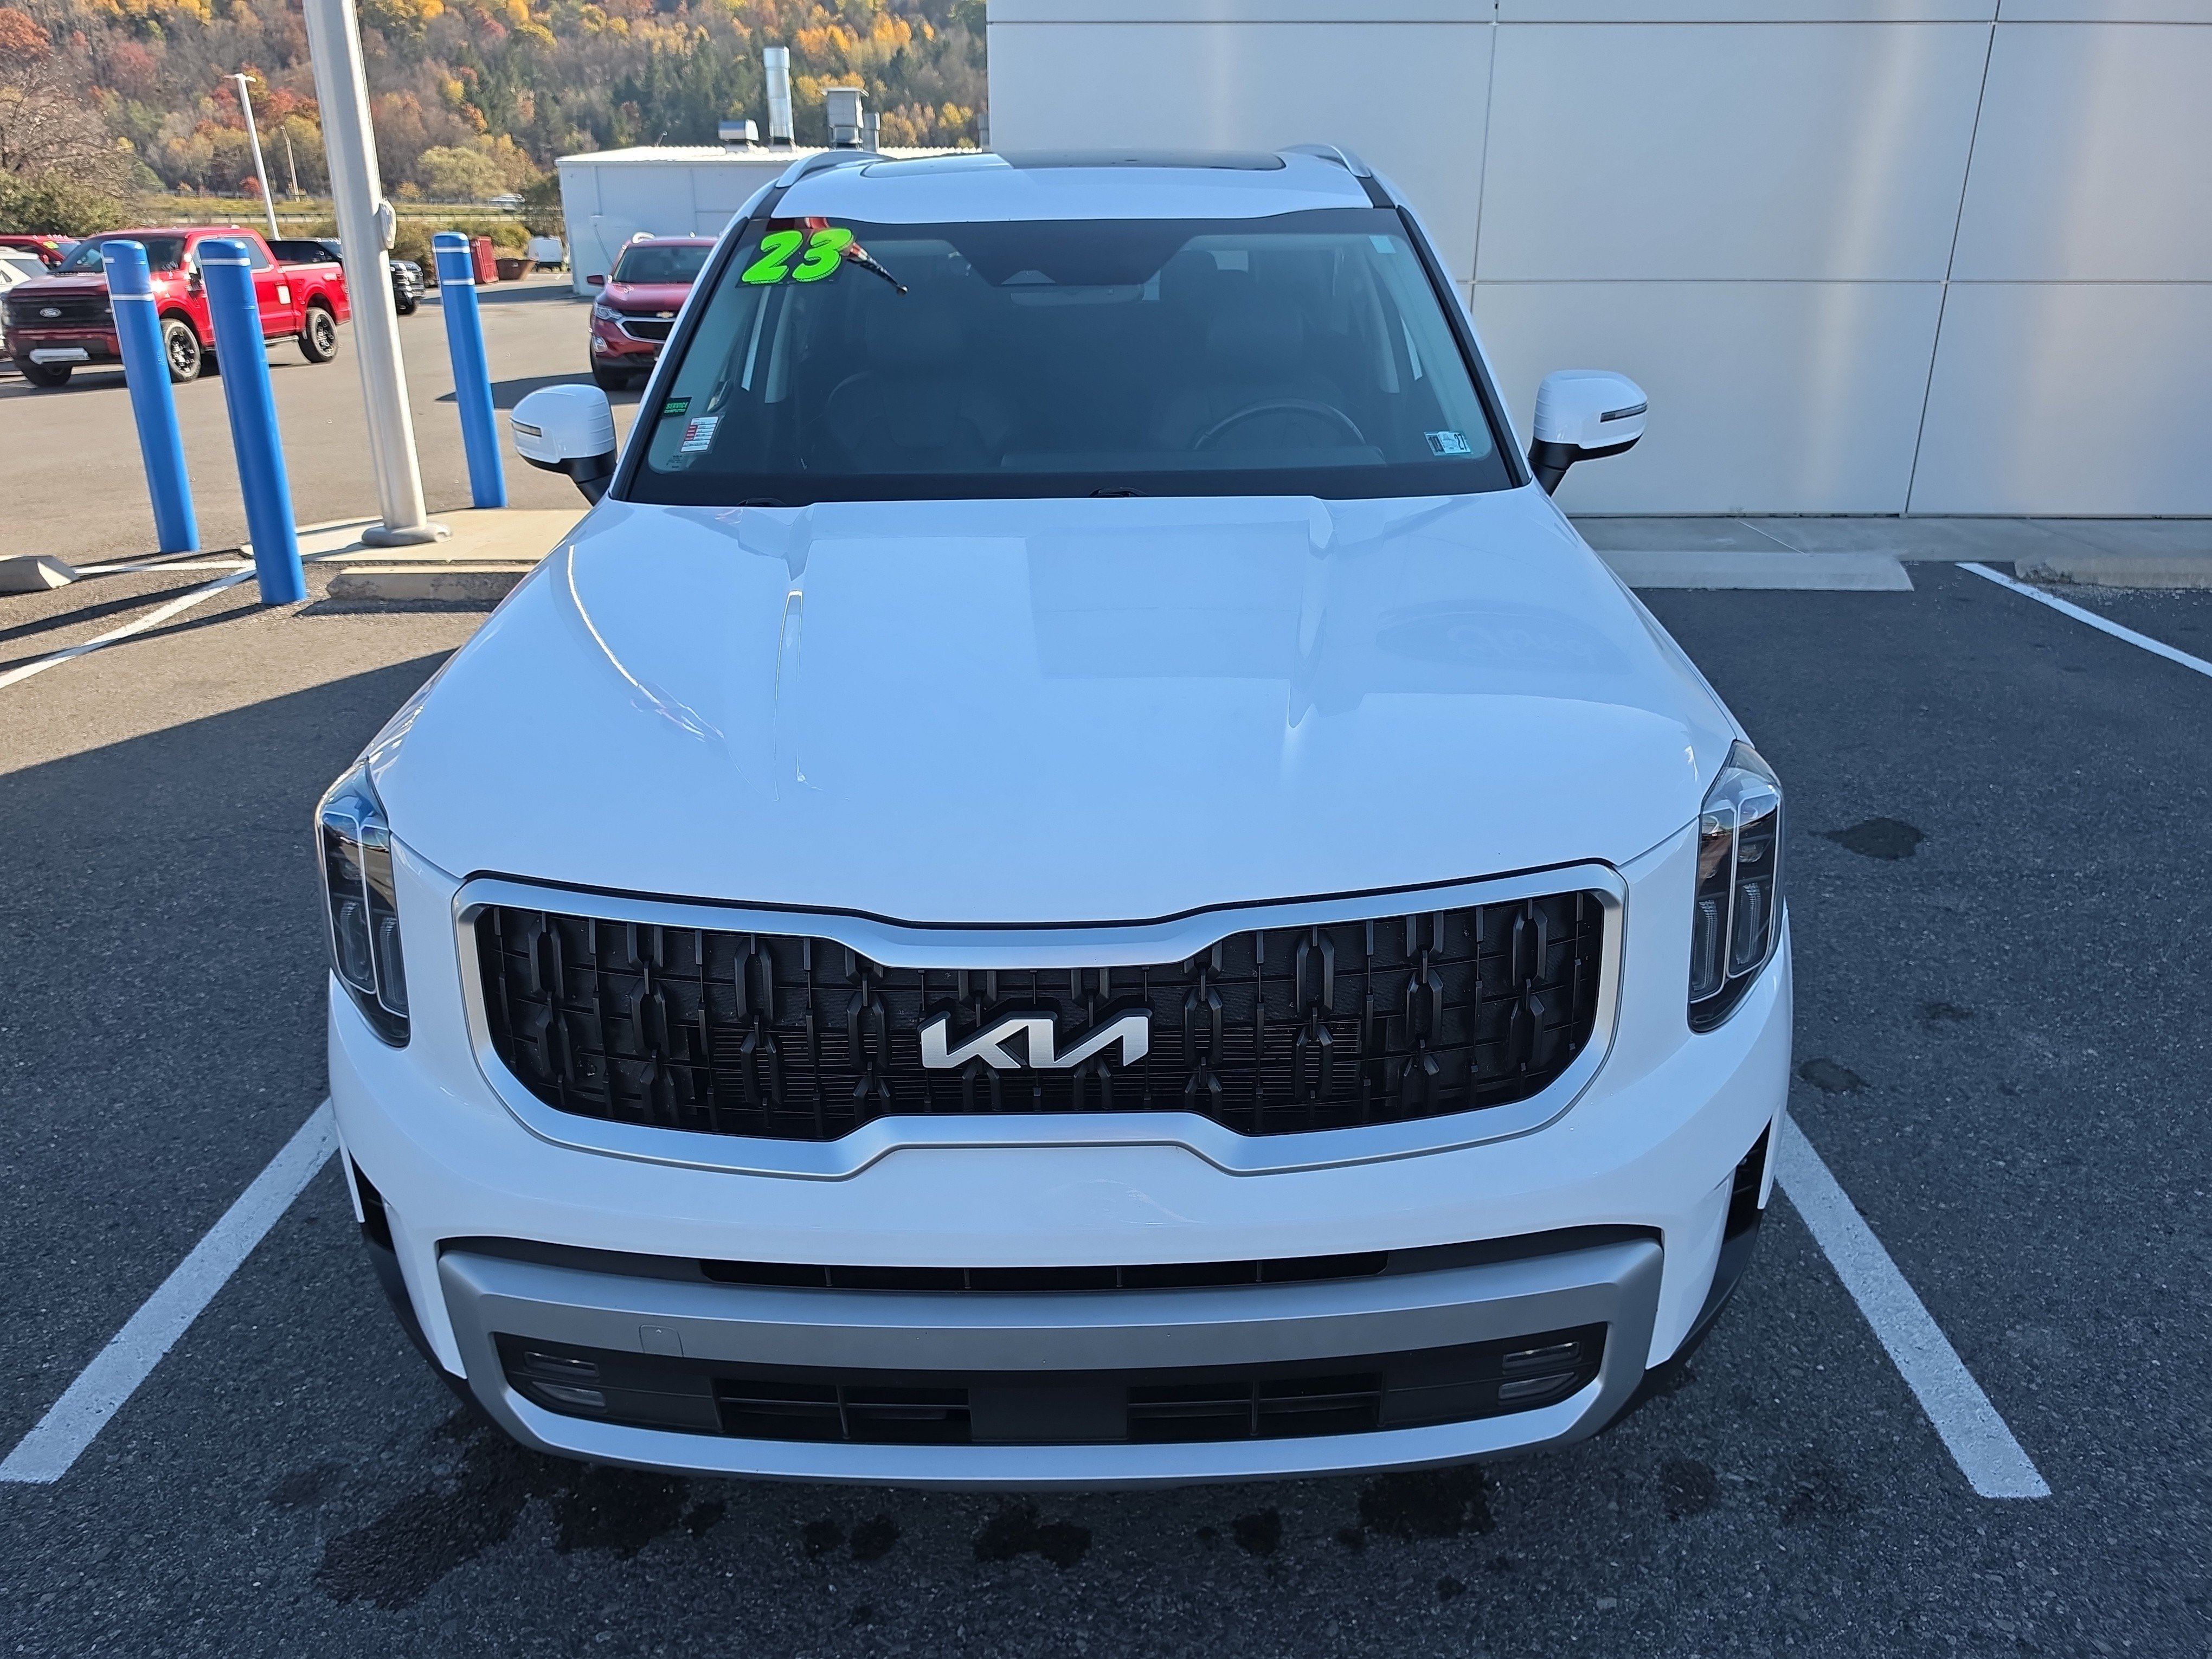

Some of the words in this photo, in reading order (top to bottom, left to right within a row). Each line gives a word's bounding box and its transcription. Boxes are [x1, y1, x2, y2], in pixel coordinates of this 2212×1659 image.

[741, 228, 854, 285] 23
[1454, 434, 1467, 451] 27
[920, 1015, 1149, 1069] KIA
